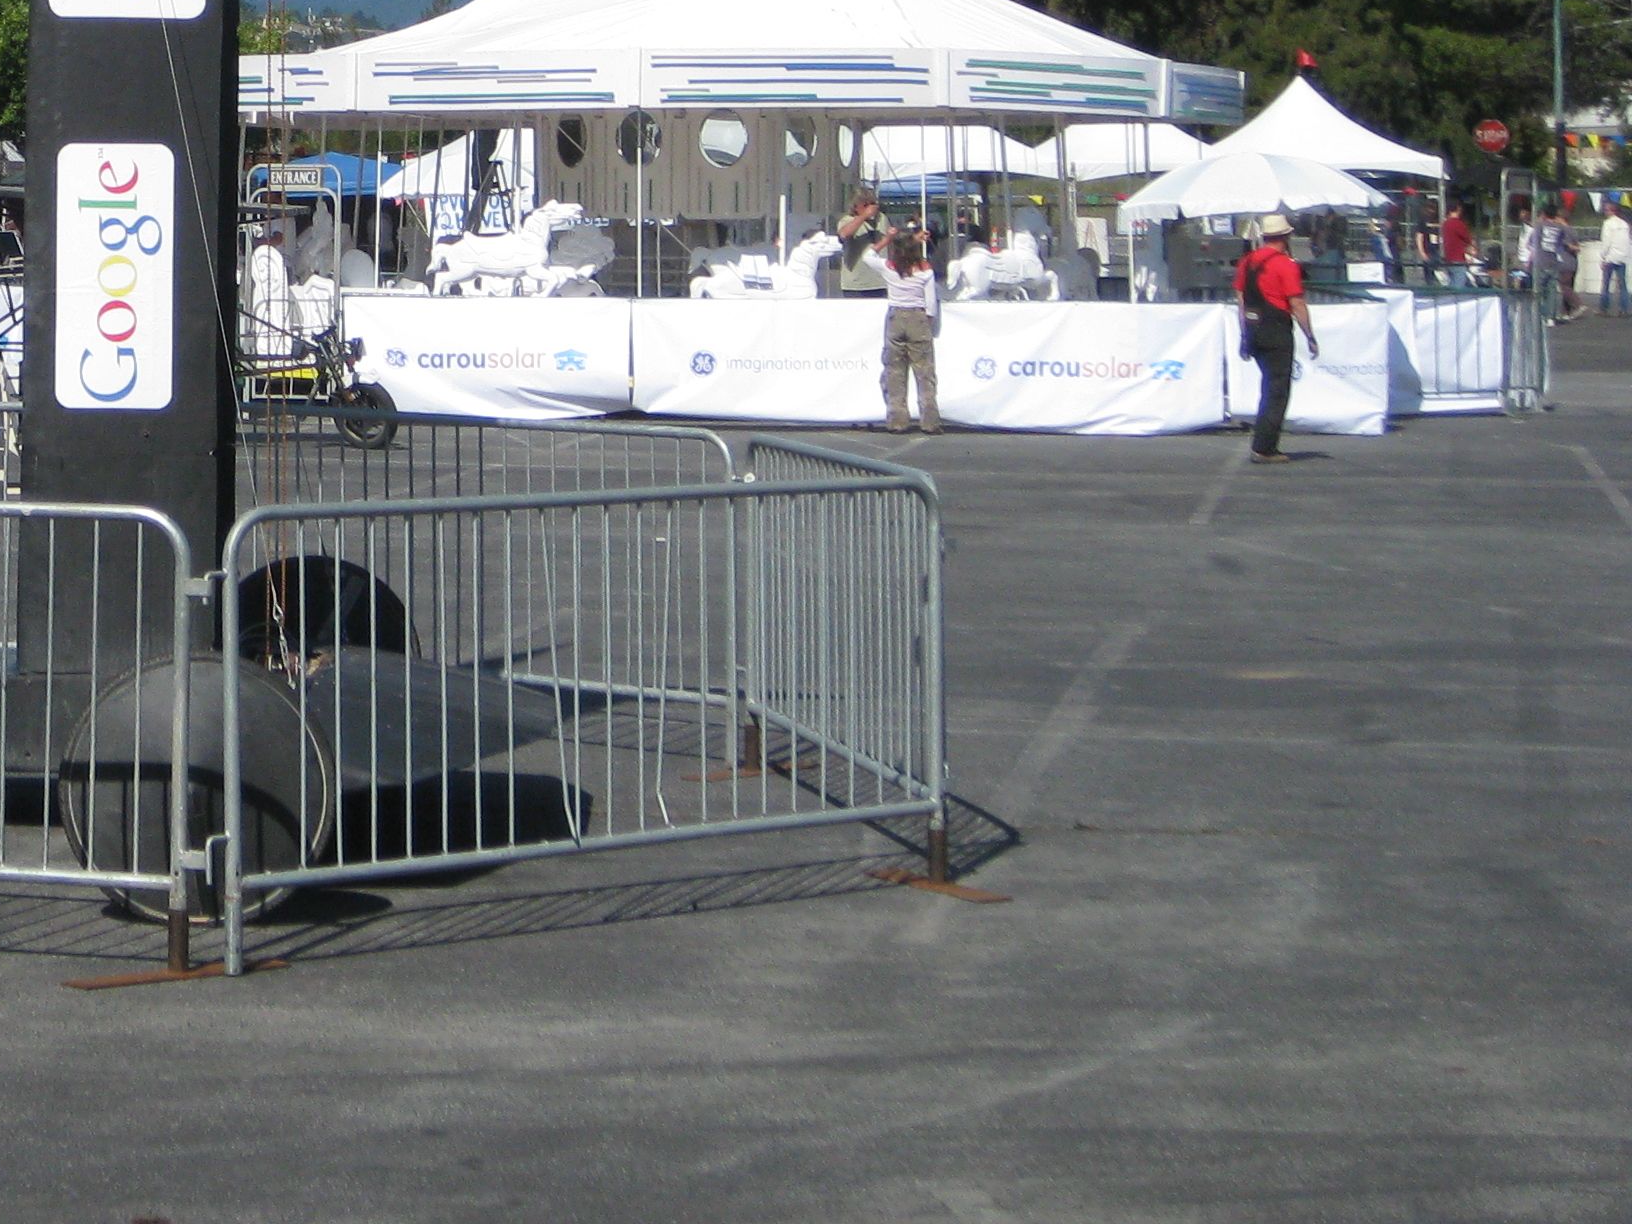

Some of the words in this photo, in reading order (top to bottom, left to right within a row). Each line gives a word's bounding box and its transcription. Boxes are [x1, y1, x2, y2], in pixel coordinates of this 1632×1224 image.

[271, 171, 317, 184] ENTRANCE
[77, 159, 163, 403] Google
[417, 347, 546, 369] carousolar
[726, 357, 806, 374] imagination
[814, 358, 829, 371] at
[832, 359, 869, 370] work
[1008, 356, 1144, 378] carousolar
